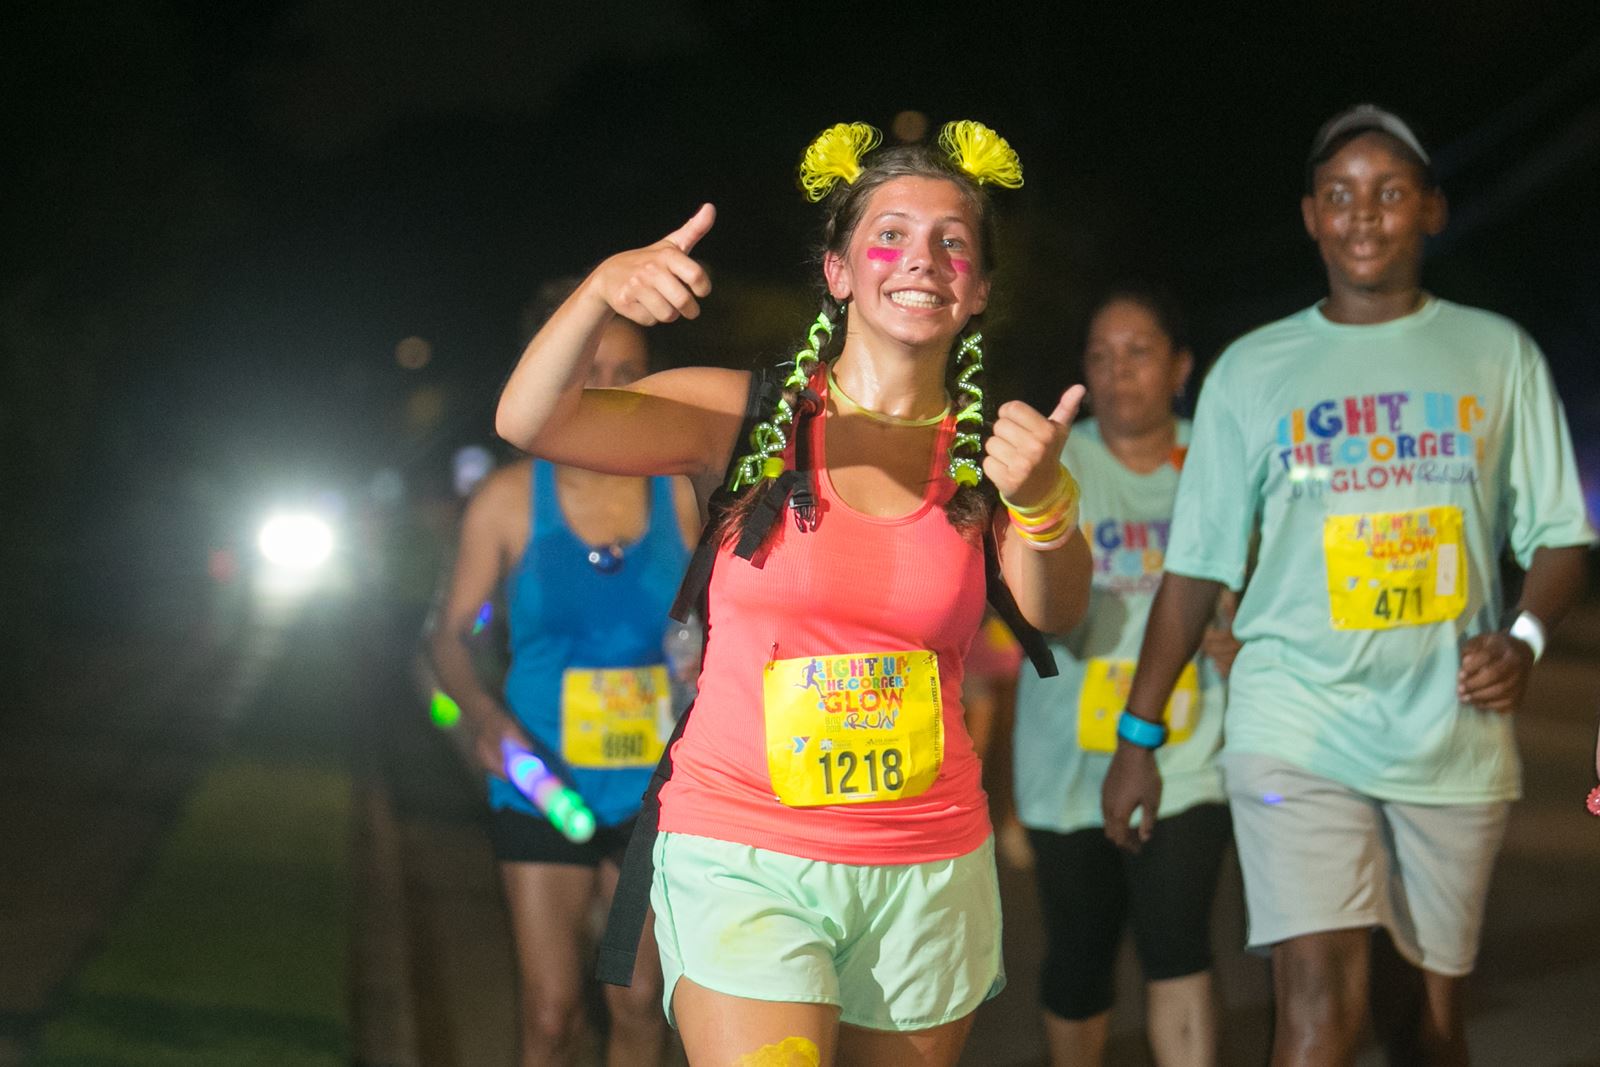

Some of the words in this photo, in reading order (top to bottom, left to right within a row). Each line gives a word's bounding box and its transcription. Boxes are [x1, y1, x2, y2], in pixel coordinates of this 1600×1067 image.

[1280, 442, 1332, 472] THE
[1331, 464, 1416, 493] GLOW
[1374, 586, 1424, 621] 471
[818, 679, 845, 692] THE
[846, 675, 910, 691] CORNERS
[823, 688, 904, 714] GLOW
[846, 711, 896, 730] RUN
[818, 748, 905, 795] 1218
